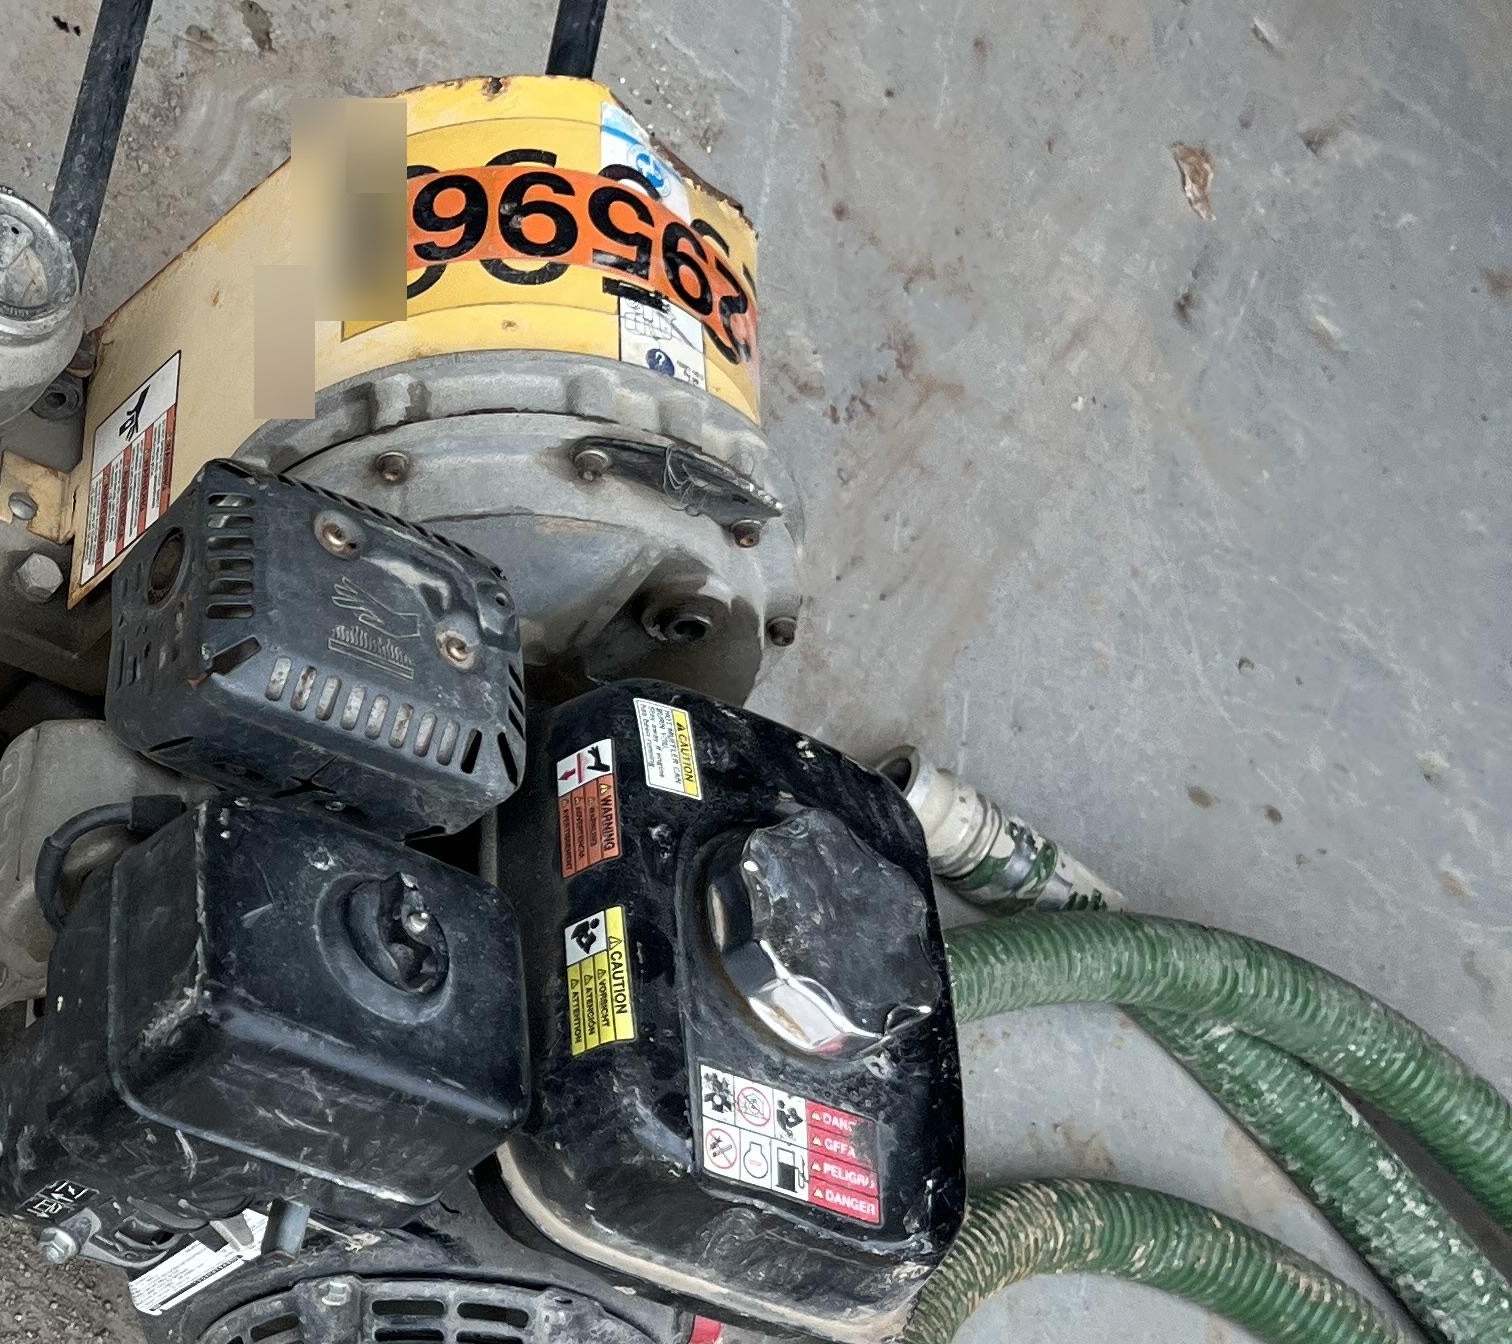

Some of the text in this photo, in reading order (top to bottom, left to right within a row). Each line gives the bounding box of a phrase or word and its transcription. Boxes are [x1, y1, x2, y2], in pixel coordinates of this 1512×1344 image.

[678, 733, 694, 783] CAUTION
[600, 795, 615, 852] WARNING
[598, 978, 610, 1027] VORSICHT
[610, 950, 628, 1015] CAUTION
[572, 991, 582, 1043] ATTENTION
